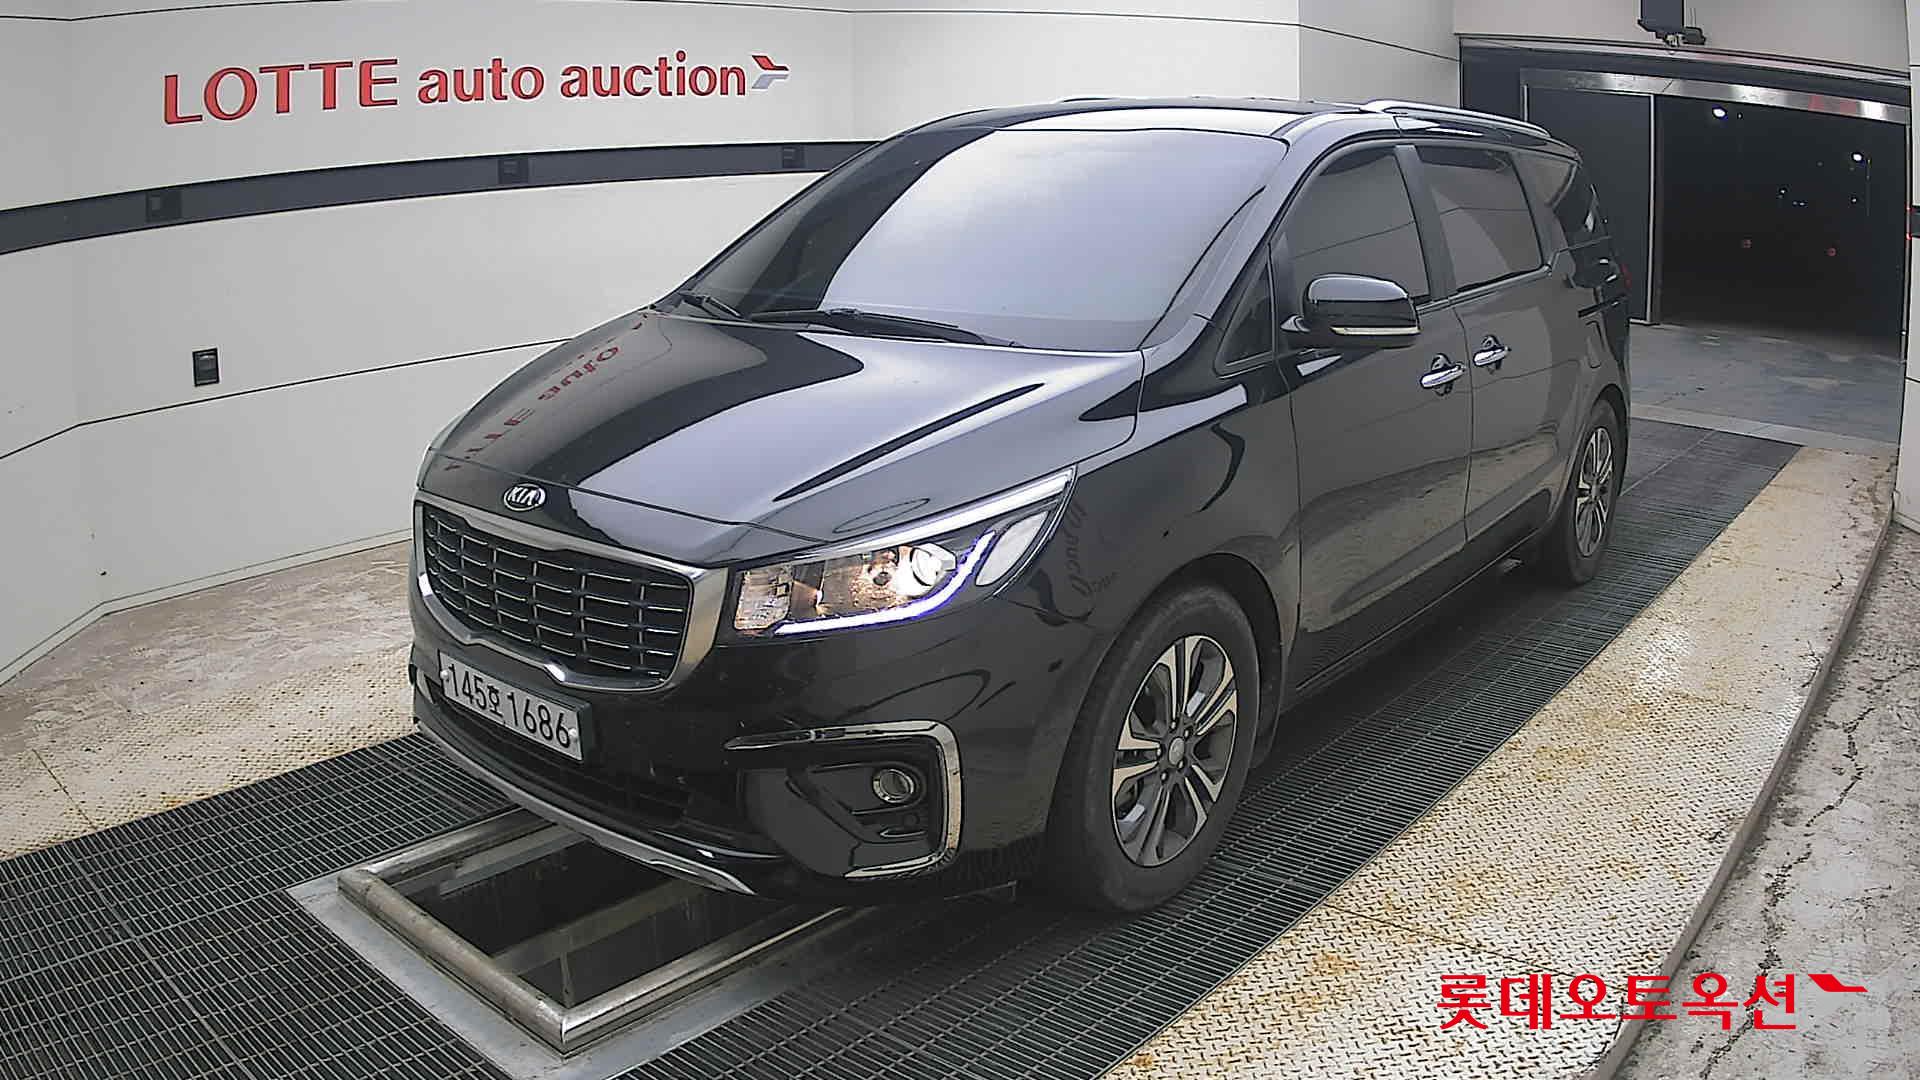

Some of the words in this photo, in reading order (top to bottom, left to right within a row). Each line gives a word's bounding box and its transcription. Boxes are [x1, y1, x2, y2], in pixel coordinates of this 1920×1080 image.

[163, 57, 399, 125] LOTTE
[417, 57, 545, 105] auto
[560, 50, 747, 99] auction
[506, 485, 539, 507] KIA
[448, 663, 503, 718] 145호
[507, 691, 571, 749] 1686
